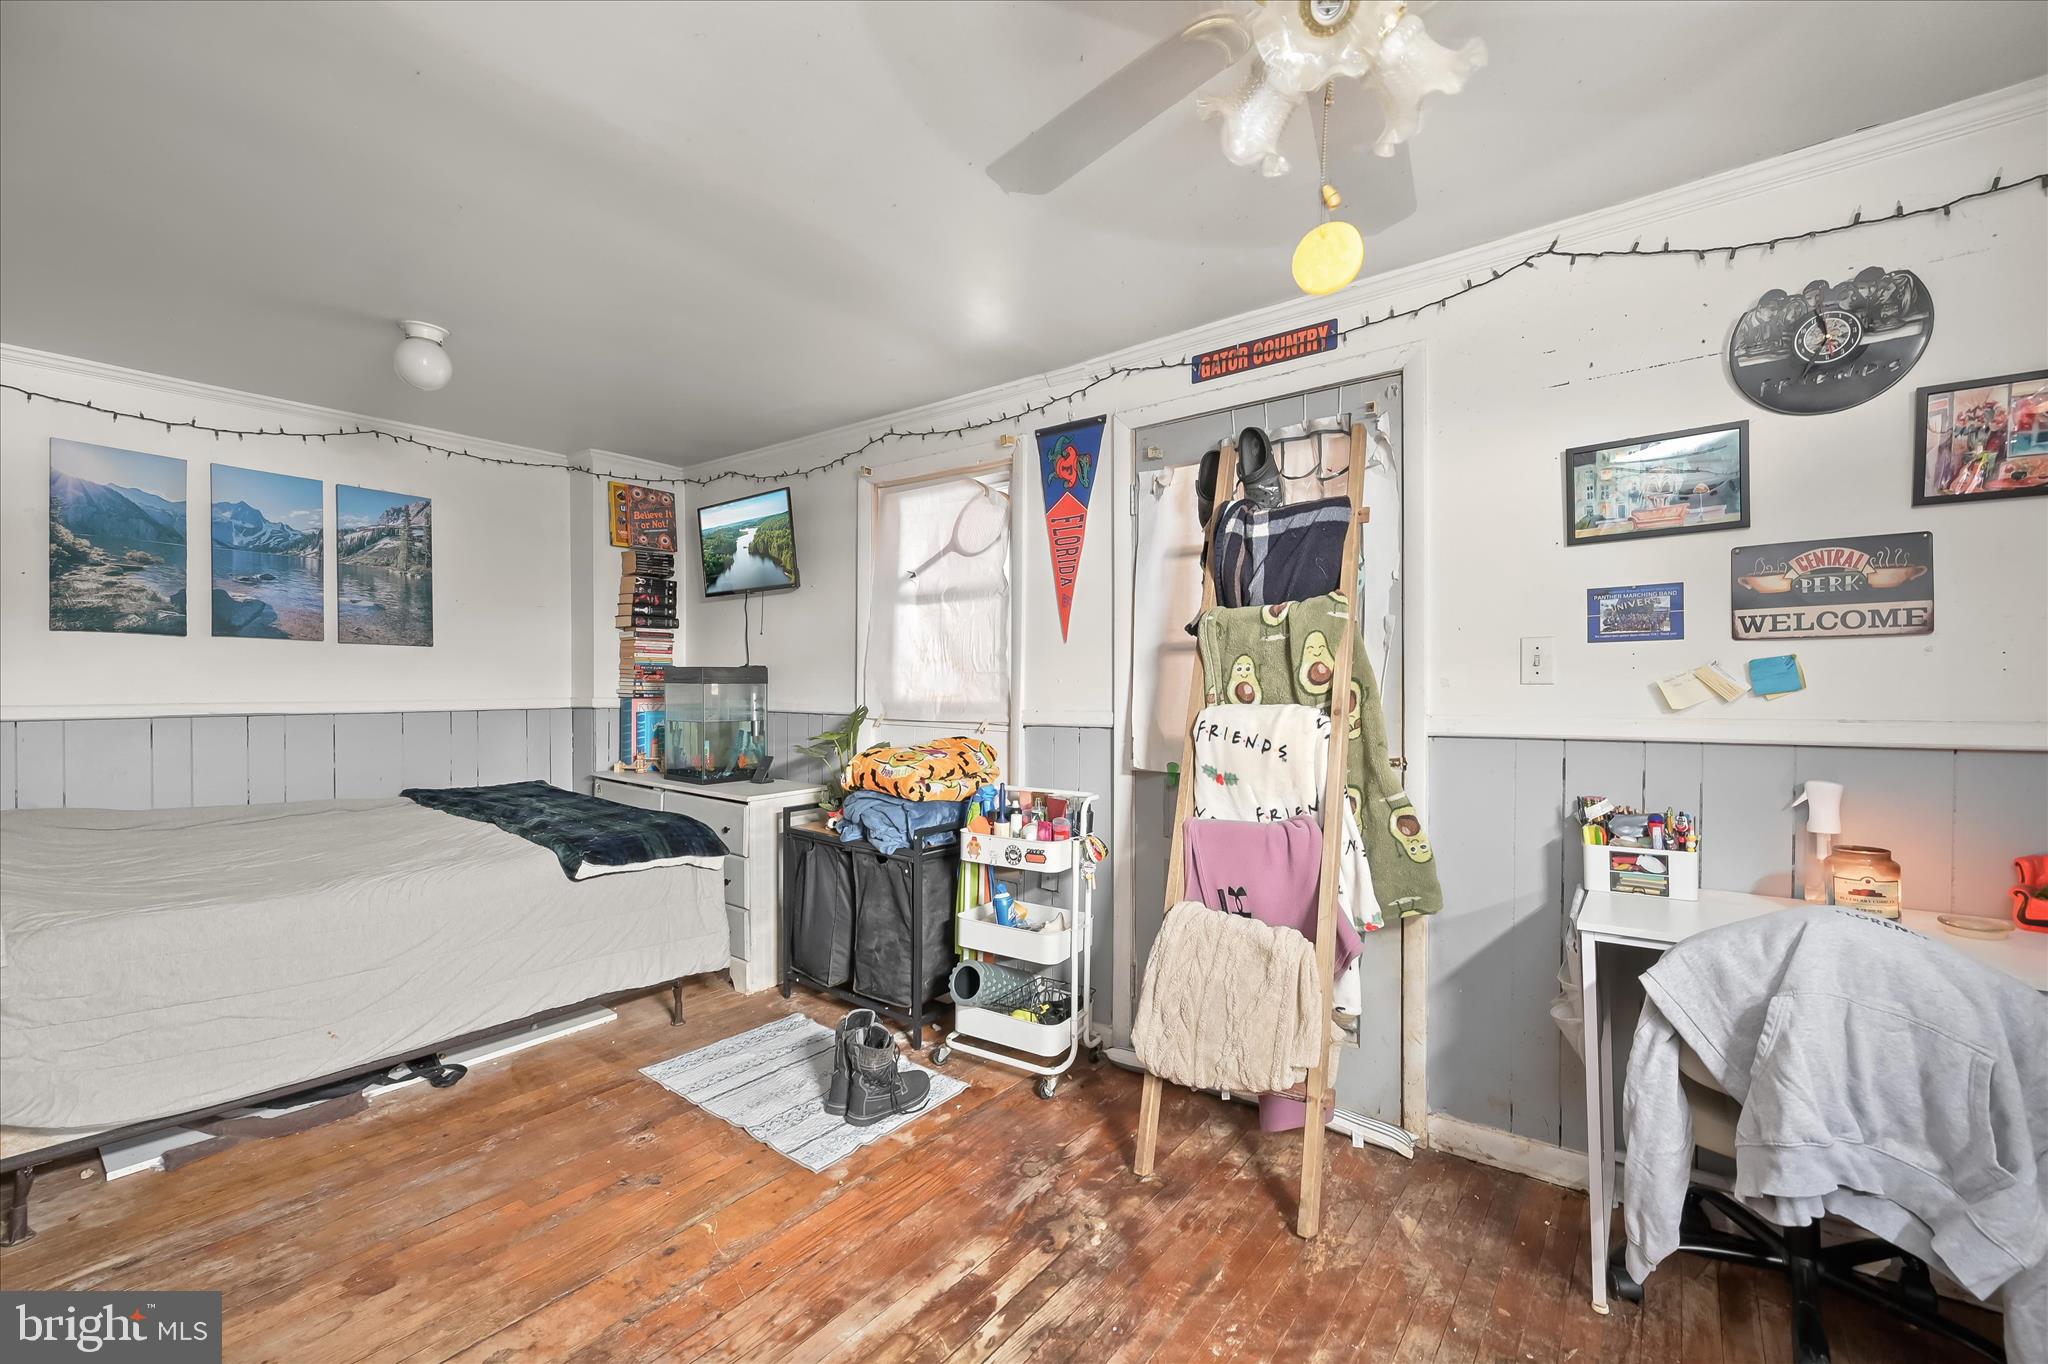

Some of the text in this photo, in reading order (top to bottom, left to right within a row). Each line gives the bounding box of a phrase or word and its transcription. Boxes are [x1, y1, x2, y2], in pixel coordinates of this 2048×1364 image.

[1200, 324, 1329, 378] GATOR COUNTRY
[633, 509, 673, 520] Believe It
[651, 519, 669, 528] Not!
[1051, 513, 1085, 587] FLORIDA
[1795, 548, 1866, 572] CENTRAL
[1801, 574, 1862, 593] PERK
[1737, 606, 1929, 634] WELCOME
